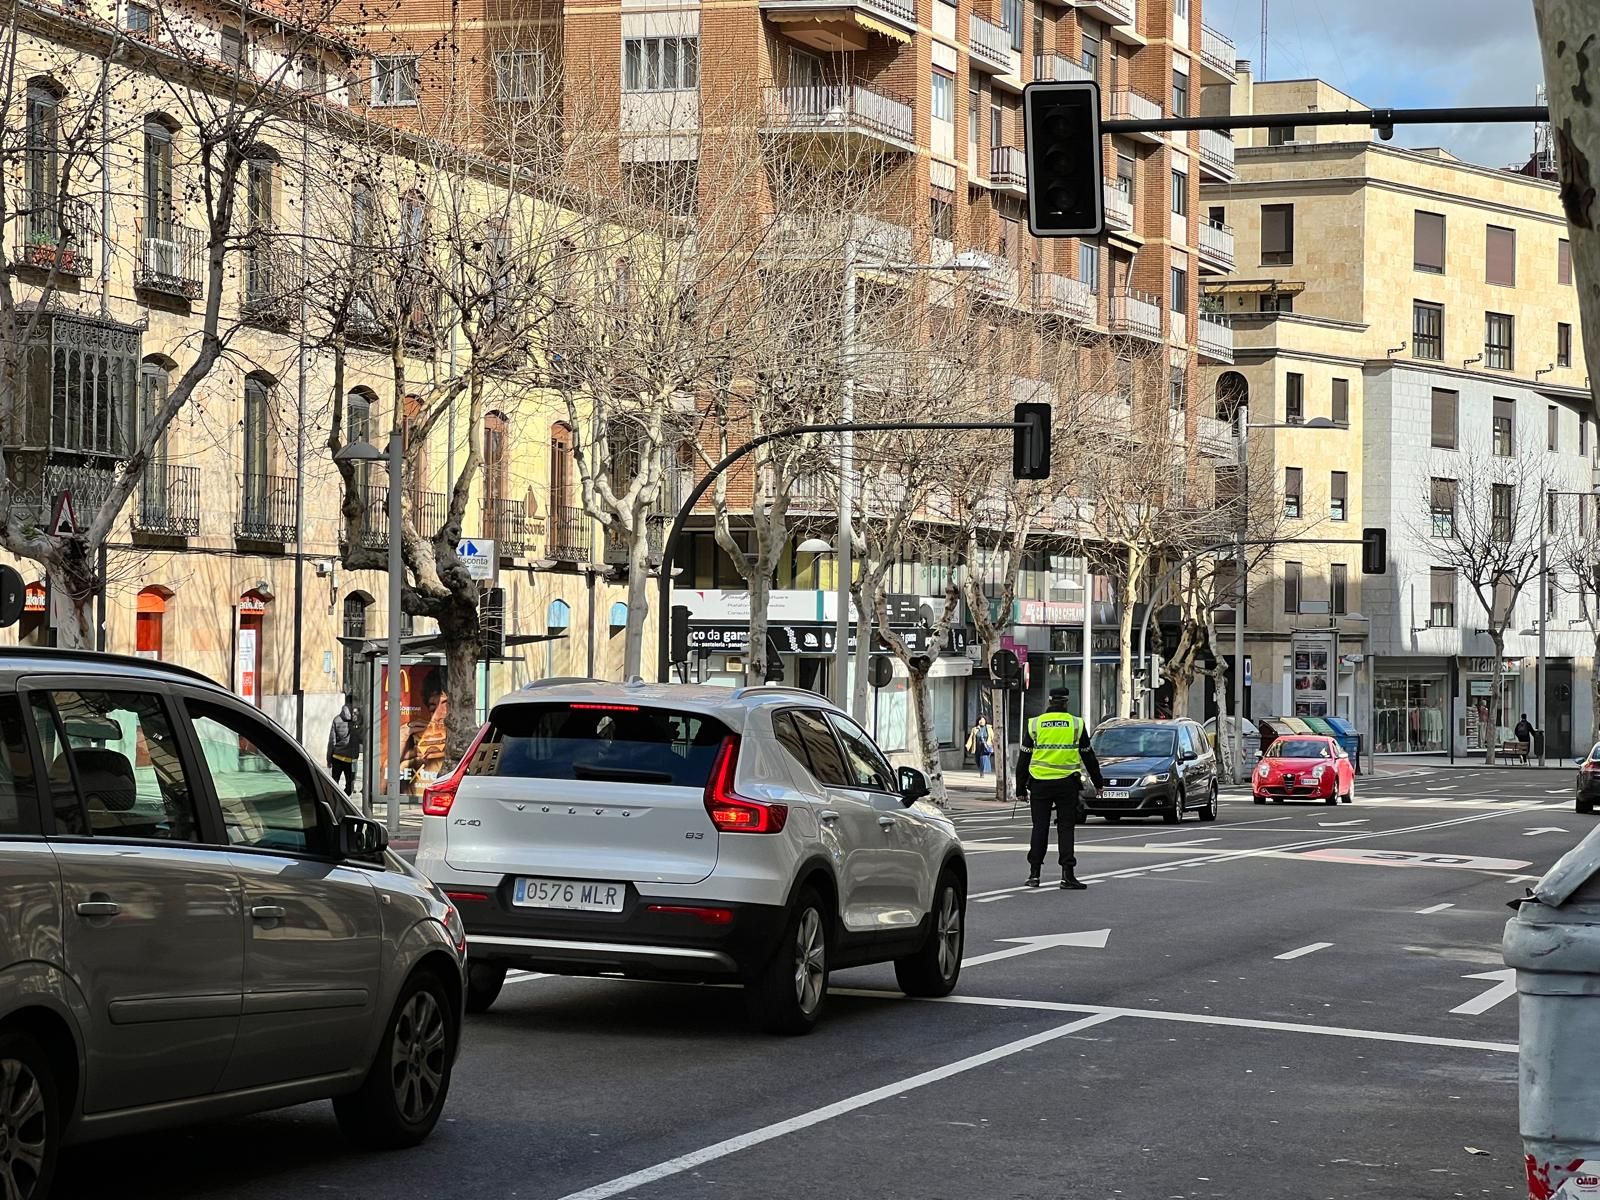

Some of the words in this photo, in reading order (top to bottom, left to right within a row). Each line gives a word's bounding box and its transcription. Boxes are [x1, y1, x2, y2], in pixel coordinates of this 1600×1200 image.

[707, 628, 721, 640] da
[723, 631, 751, 643] gam
[516, 804, 631, 818] VOLVO
[527, 882, 575, 903] 0576
[580, 885, 617, 906] MLR
